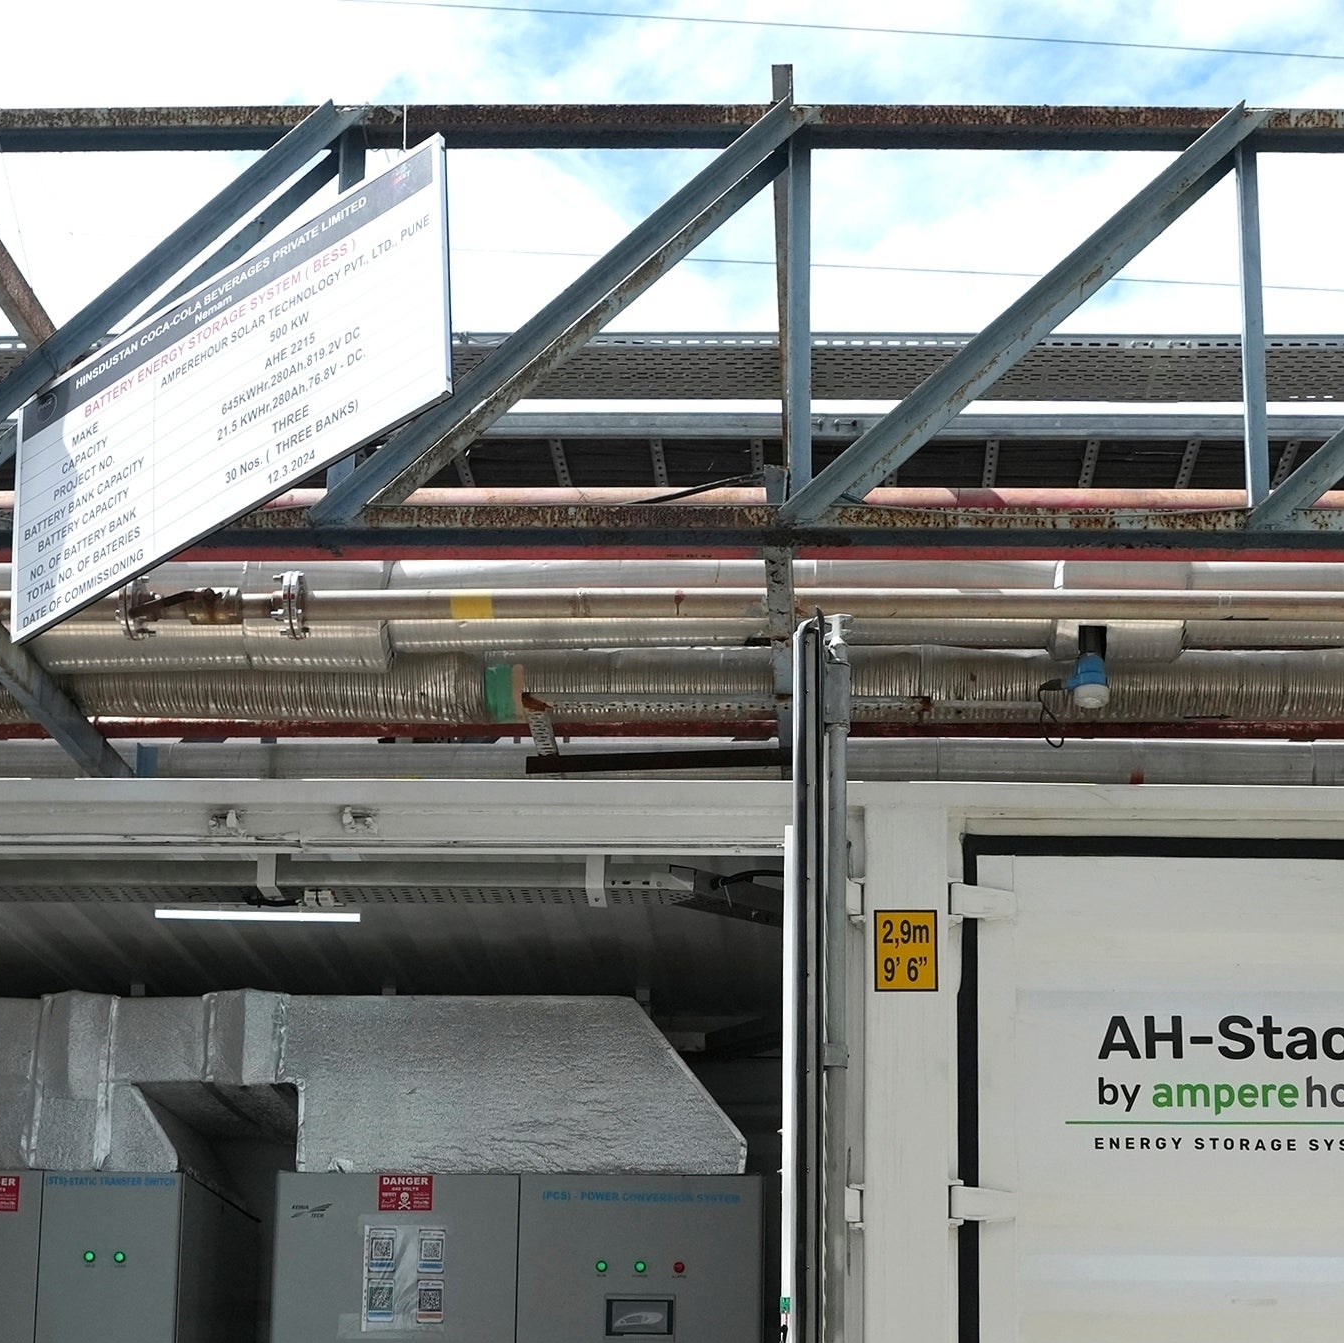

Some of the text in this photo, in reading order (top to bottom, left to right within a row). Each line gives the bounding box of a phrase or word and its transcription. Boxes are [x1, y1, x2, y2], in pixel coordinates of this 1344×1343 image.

[75, 196, 367, 390] HINSDUSTAN COCA-COLA BEVERAGES PRIVATE LIMITED
[160, 337, 228, 388] AMPEREHOUR
[231, 314, 266, 343] SOLAR
[269, 269, 341, 321] TECHNOLOGY
[400, 214, 431, 241] PUNE
[194, 295, 233, 324] Nemam
[84, 375, 135, 418] BATTERY
[137, 342, 185, 382] ENERGY
[188, 304, 247, 349] STORAGE
[250, 271, 301, 311] SYSTEM
[313, 243, 348, 273] BESS
[269, 311, 310, 342] 500 KW
[344, 326, 361, 344] DC
[264, 332, 316, 370] AHE 2215
[71, 422, 99, 447] MAKE
[217, 420, 238, 441] 21.5
[272, 404, 310, 434] THREE
[61, 437, 108, 475] CAPACITY
[225, 468, 237, 485] 30
[239, 457, 263, 477] Nos.
[275, 425, 313, 455] THREE
[268, 449, 316, 485] 12.3.2024
[53, 455, 115, 500] PROJECT NO.
[24, 457, 144, 541] BATTERY BANK CAPACITY
[37, 487, 129, 553] BATTERY CAPACITY
[30, 507, 137, 581] NO. OF BATTERY BANK
[27, 526, 141, 603] TOTAL NO. OF BATERIES
[23, 548, 144, 628] DATE OF COMMISSIONING
[881, 920, 930, 949] 2,9m
[1098, 1077, 1141, 1112] by
[1094, 1137, 1183, 1151] ENERGY
[1194, 1137, 1297, 1152] STORAGE
[100, 1176, 142, 1186] TRANSFER
[382, 1177, 428, 1186] DANGER
[580, 1192, 619, 1201] POWER
